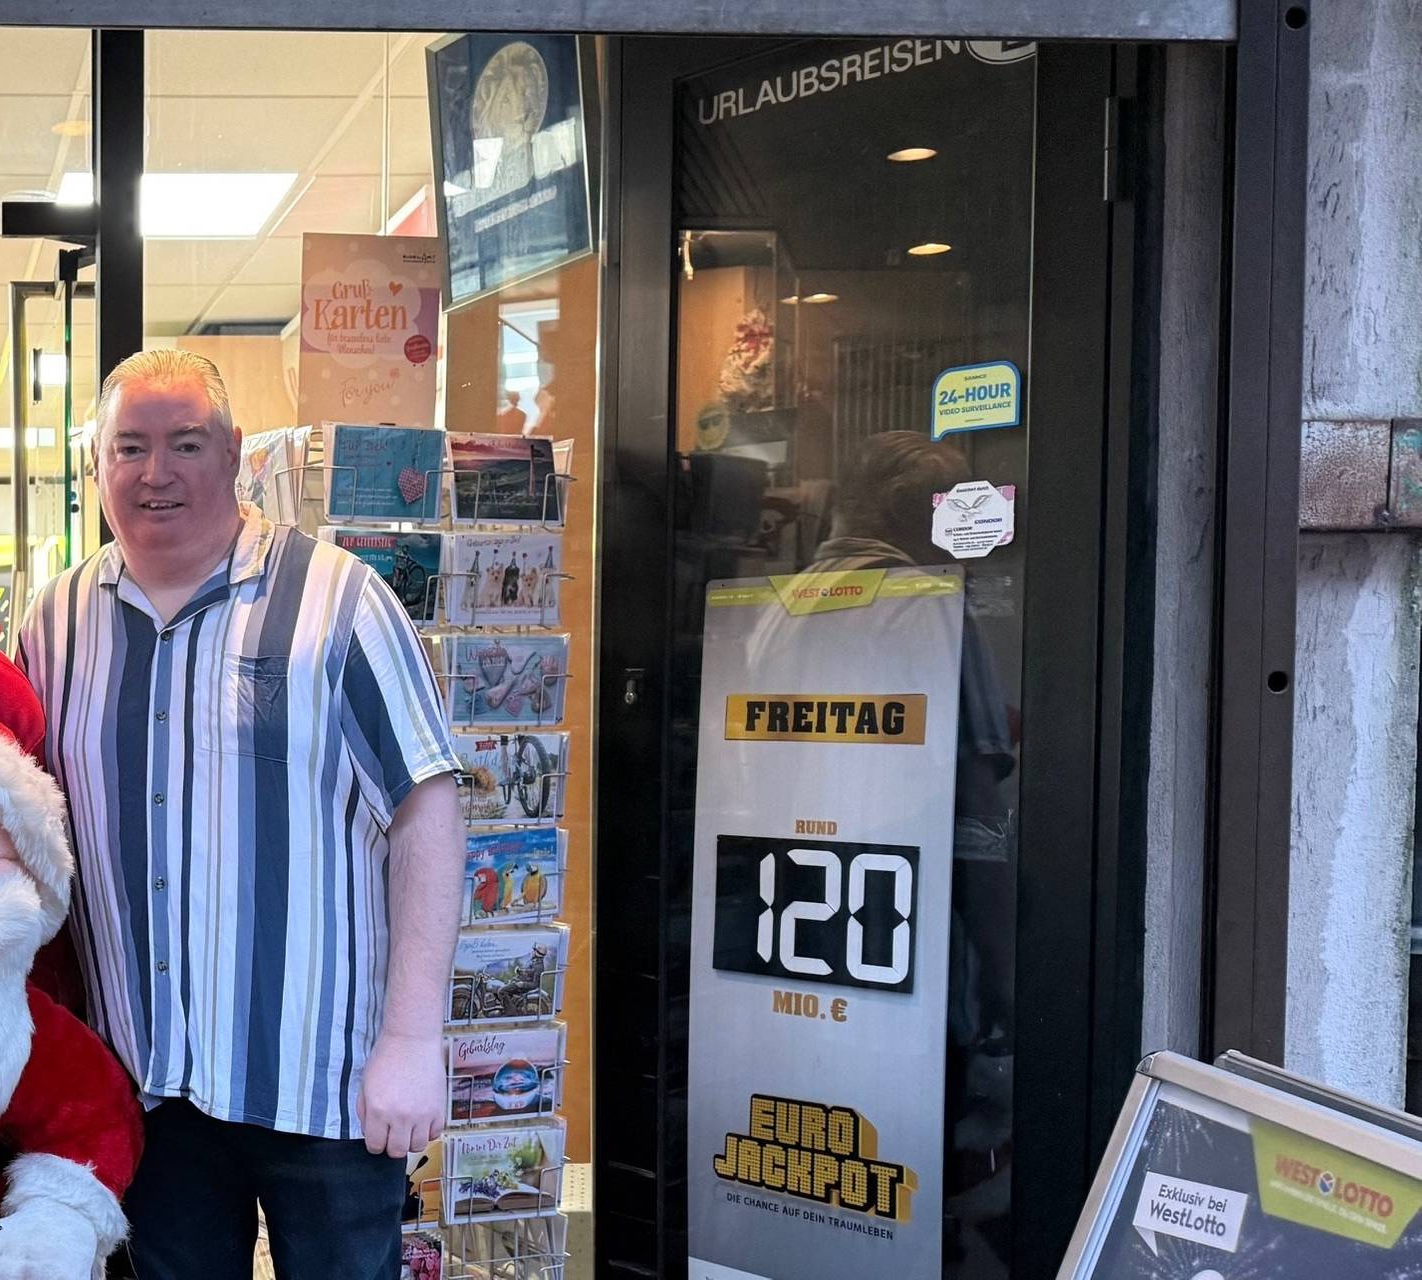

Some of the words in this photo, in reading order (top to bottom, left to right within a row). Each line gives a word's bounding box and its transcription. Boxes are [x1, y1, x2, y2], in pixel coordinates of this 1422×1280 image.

[698, 39, 961, 125] URLAUBSREISEN
[332, 278, 372, 300] Gruß
[314, 299, 408, 331] Karten
[938, 383, 1012, 406] 24-HOUR
[938, 408, 961, 416] VIDEO
[961, 400, 1012, 414] SURVEILLANCE
[829, 585, 863, 597] LOTTO
[745, 700, 906, 736] FREITAG
[795, 820, 838, 837] RUND
[756, 848, 914, 985] 120
[772, 990, 826, 1020] MIO.
[830, 998, 849, 1022] €
[458, 1036, 506, 1061] Geburtstag
[751, 1095, 859, 1156] EURO
[714, 1132, 900, 1215] JACKPOT
[1275, 1153, 1322, 1188] WEST
[1335, 1176, 1394, 1218] LOTTO
[1158, 1183, 1206, 1207] Exklusiv
[1207, 1195, 1229, 1212] bei
[726, 1192, 742, 1204] DIE
[743, 1196, 780, 1213] CHANCE
[782, 1205, 801, 1217] AUF
[803, 1211, 826, 1224] DEIN
[828, 1216, 894, 1241] TRAUMLEBEN
[1149, 1199, 1227, 1237] WestLotto
